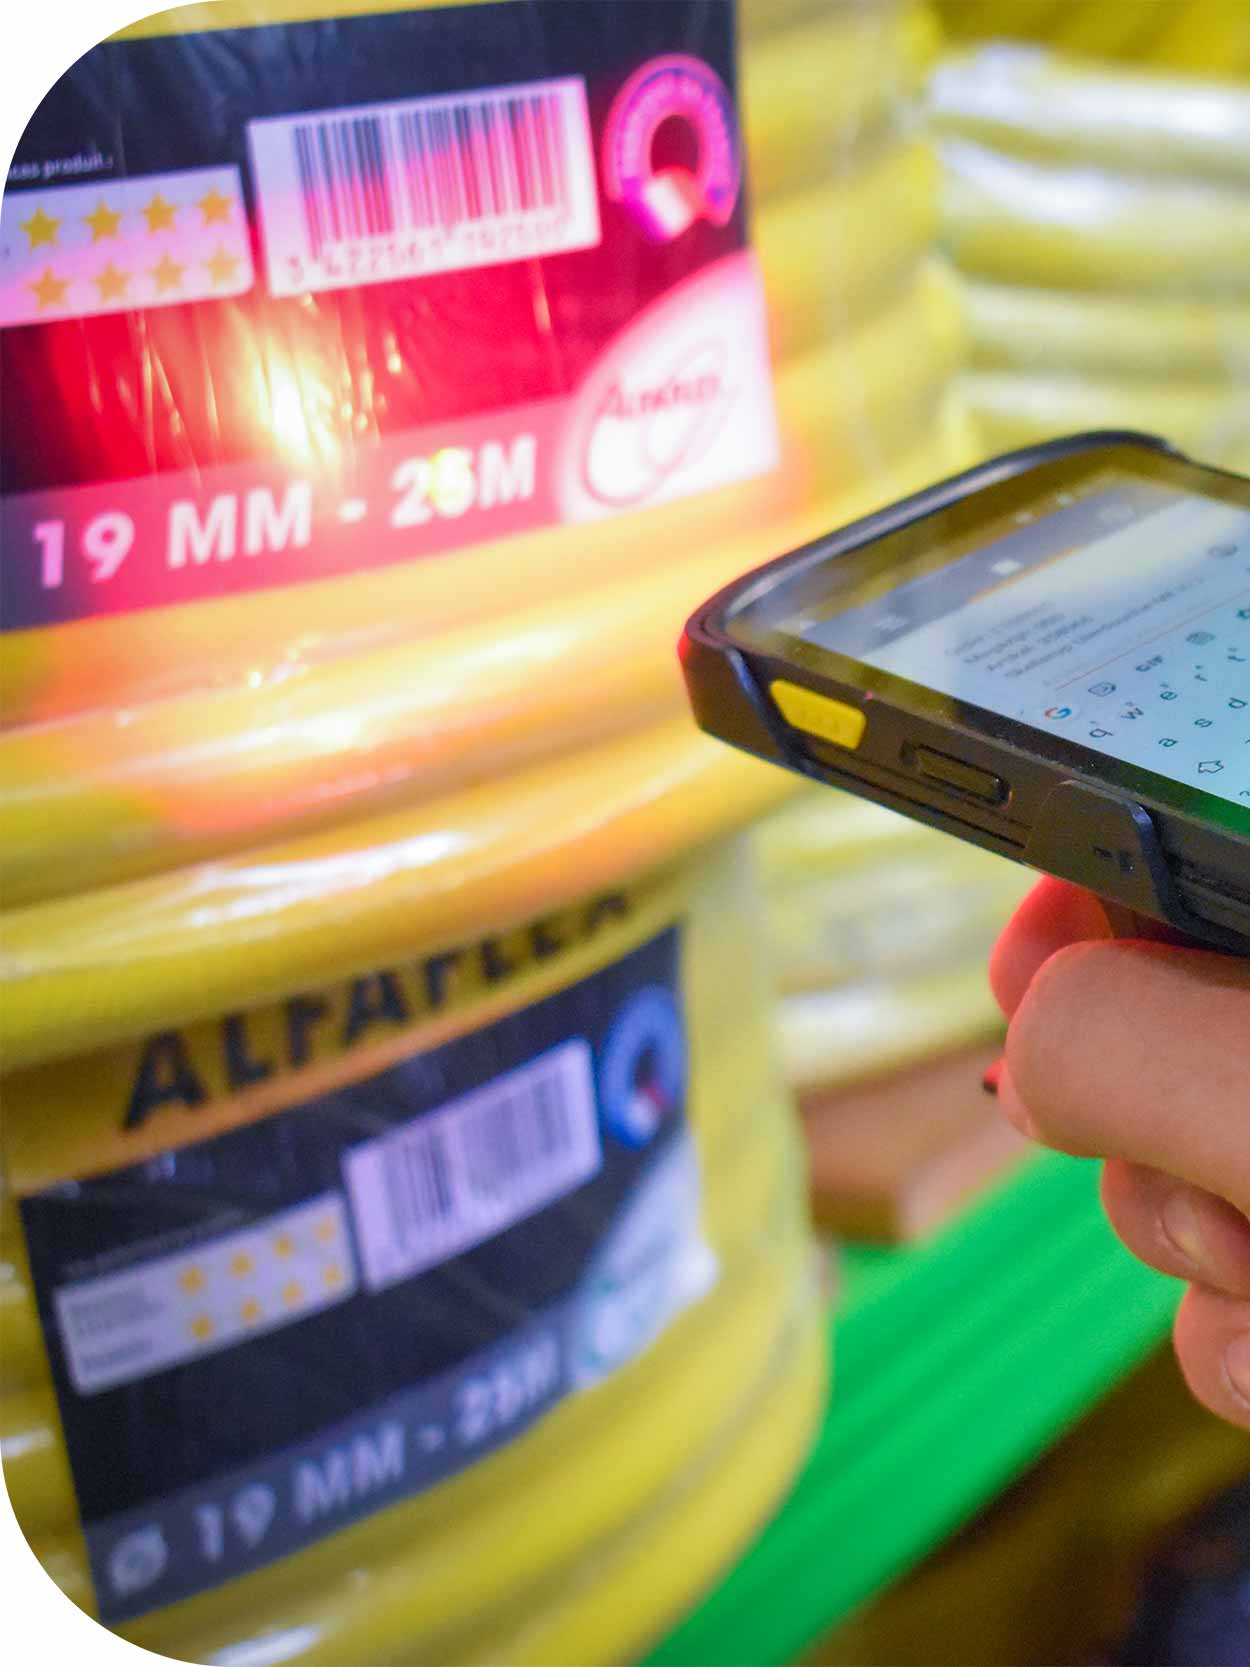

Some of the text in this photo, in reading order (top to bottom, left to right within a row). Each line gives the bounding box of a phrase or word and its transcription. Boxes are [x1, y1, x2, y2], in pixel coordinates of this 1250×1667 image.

[34, 511, 135, 588] 19
[166, 480, 313, 569] MM
[1089, 728, 1113, 738] q
[1121, 707, 1144, 720] w
[1160, 691, 1178, 700] e
[1158, 737, 1179, 748] a
[1194, 718, 1213, 728] s
[1228, 697, 1248, 709] d
[294, 1421, 405, 1523] MM
